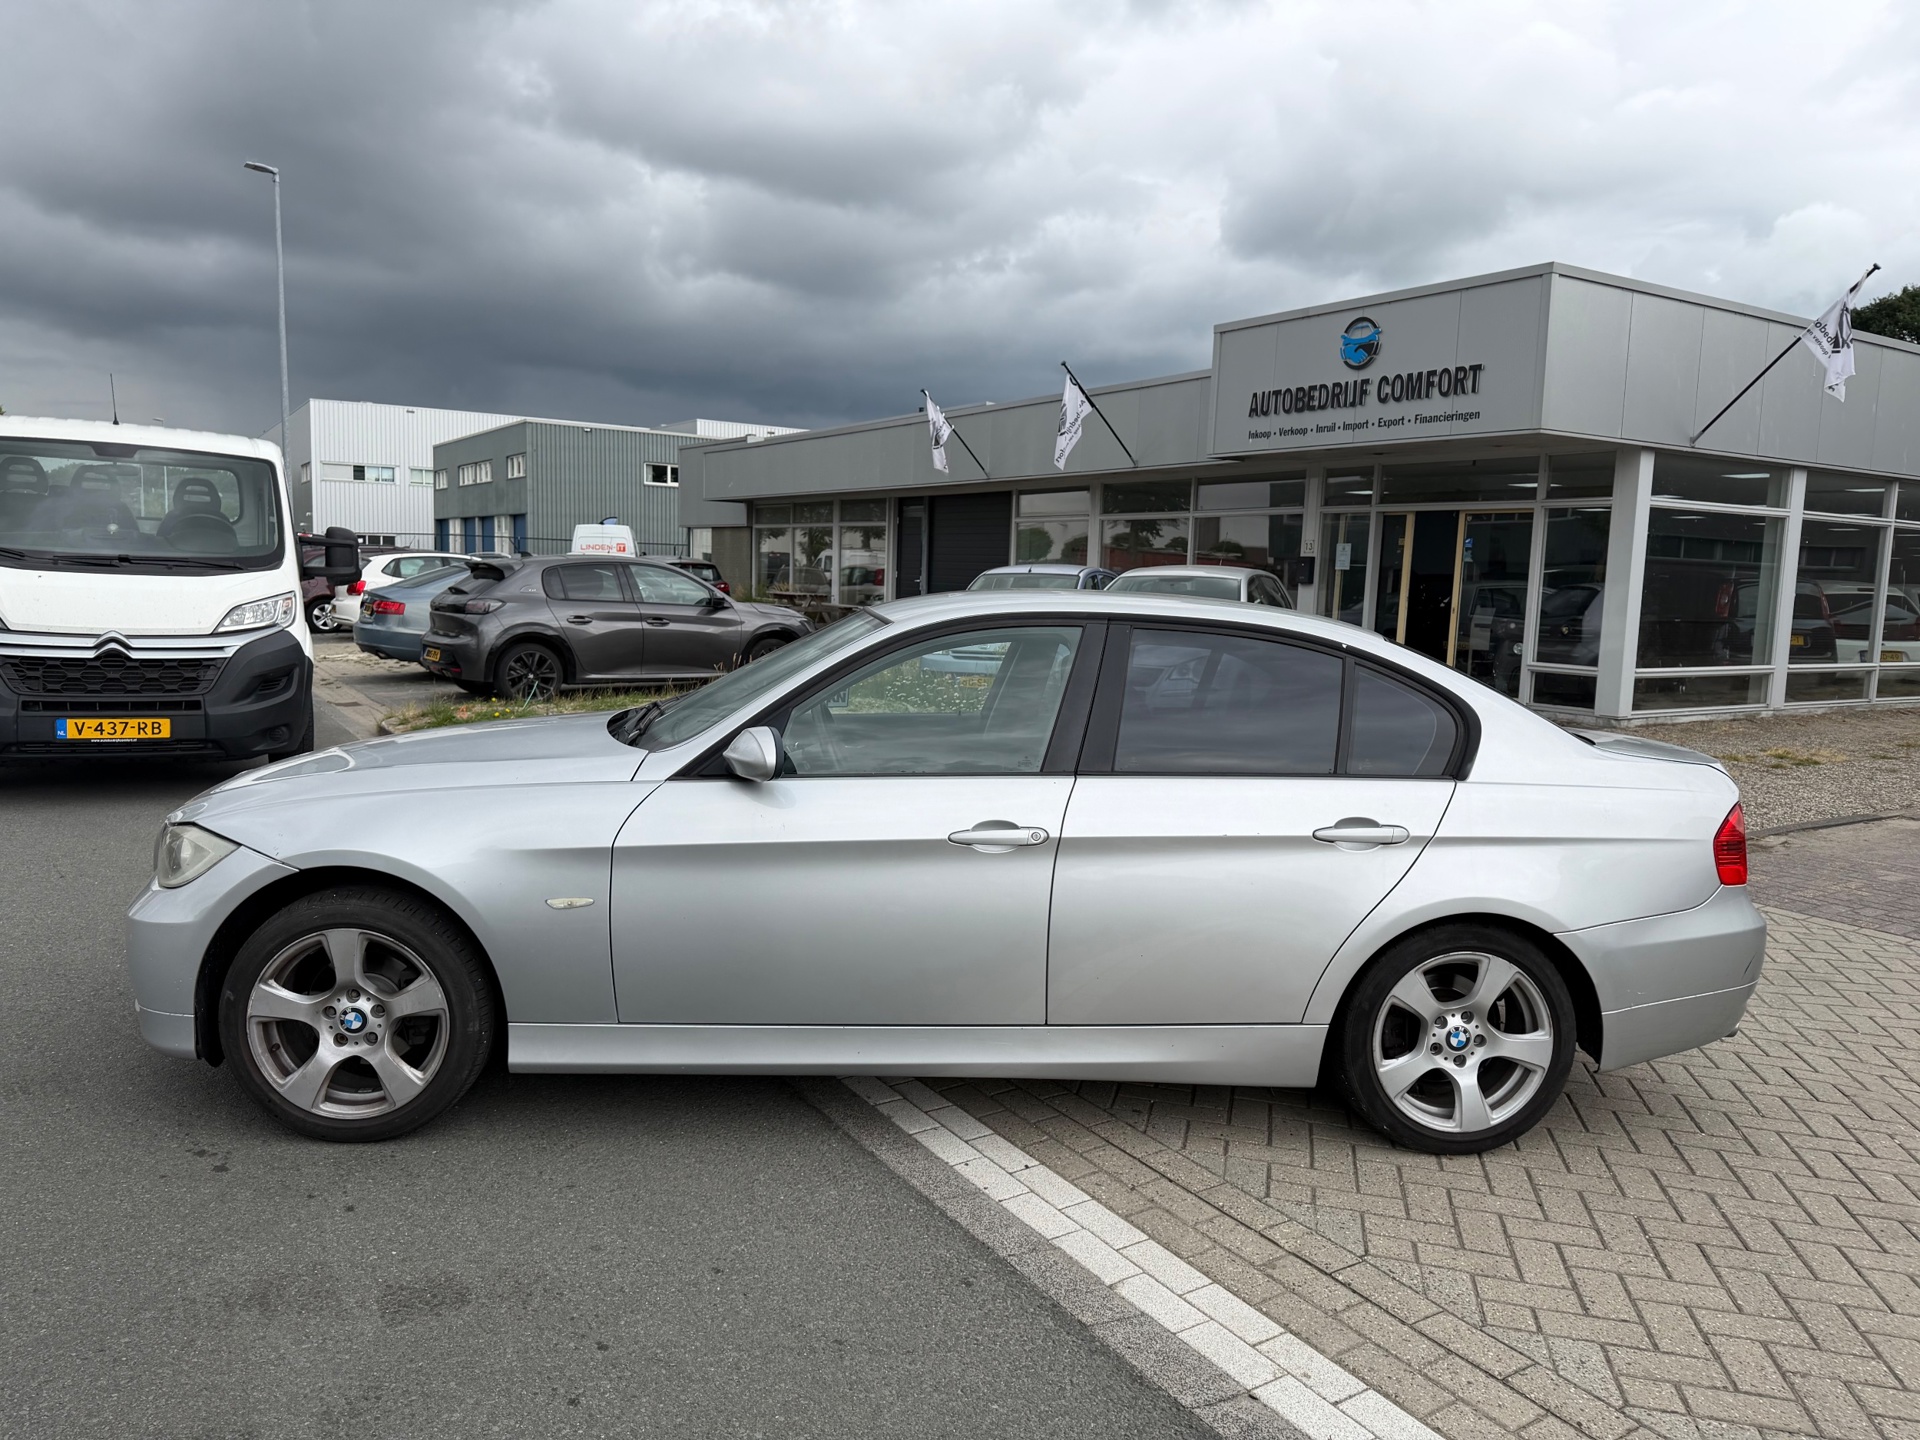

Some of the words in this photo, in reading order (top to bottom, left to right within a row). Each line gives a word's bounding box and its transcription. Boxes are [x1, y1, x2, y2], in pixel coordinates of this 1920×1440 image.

[1248, 378, 1371, 417] AUTOBEDRIJF
[1377, 363, 1484, 404] COMFORT
[1248, 430, 1271, 440] Inkoop
[1279, 426, 1308, 437] Verkoop
[1316, 422, 1336, 433] Inruil
[1342, 419, 1369, 432] Import
[1377, 416, 1405, 429] Export
[1414, 410, 1480, 424] Financieringen
[1305, 542, 1313, 551] 13
[74, 721, 162, 736] V-437-RB
